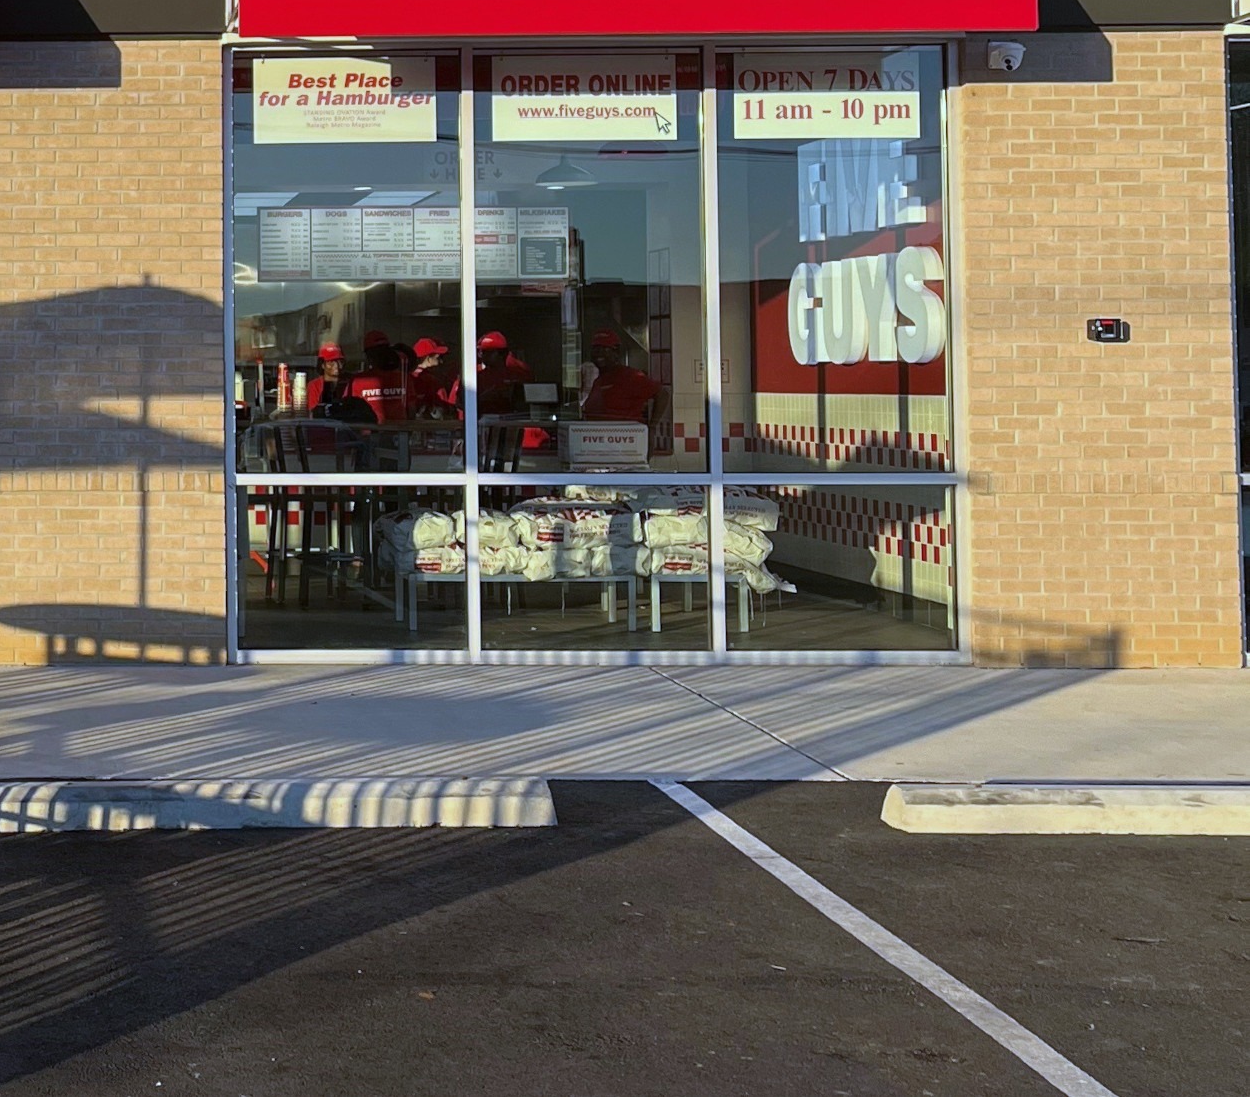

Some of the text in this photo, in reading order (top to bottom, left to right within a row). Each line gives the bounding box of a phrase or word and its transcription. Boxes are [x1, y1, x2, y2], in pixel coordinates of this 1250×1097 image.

[288, 73, 403, 88] Best Place
[501, 74, 672, 95] ORDER ONLINE
[738, 69, 915, 91] OPEN 7 DAYS
[259, 91, 434, 108] for a Hamburger
[518, 105, 656, 119] www.fiveguys.com
[743, 100, 765, 119] 11
[775, 104, 813, 119] am
[842, 99, 864, 119] 10
[873, 104, 911, 125] pm
[788, 246, 946, 365] GUYS
[362, 388, 381, 397] FIVE
